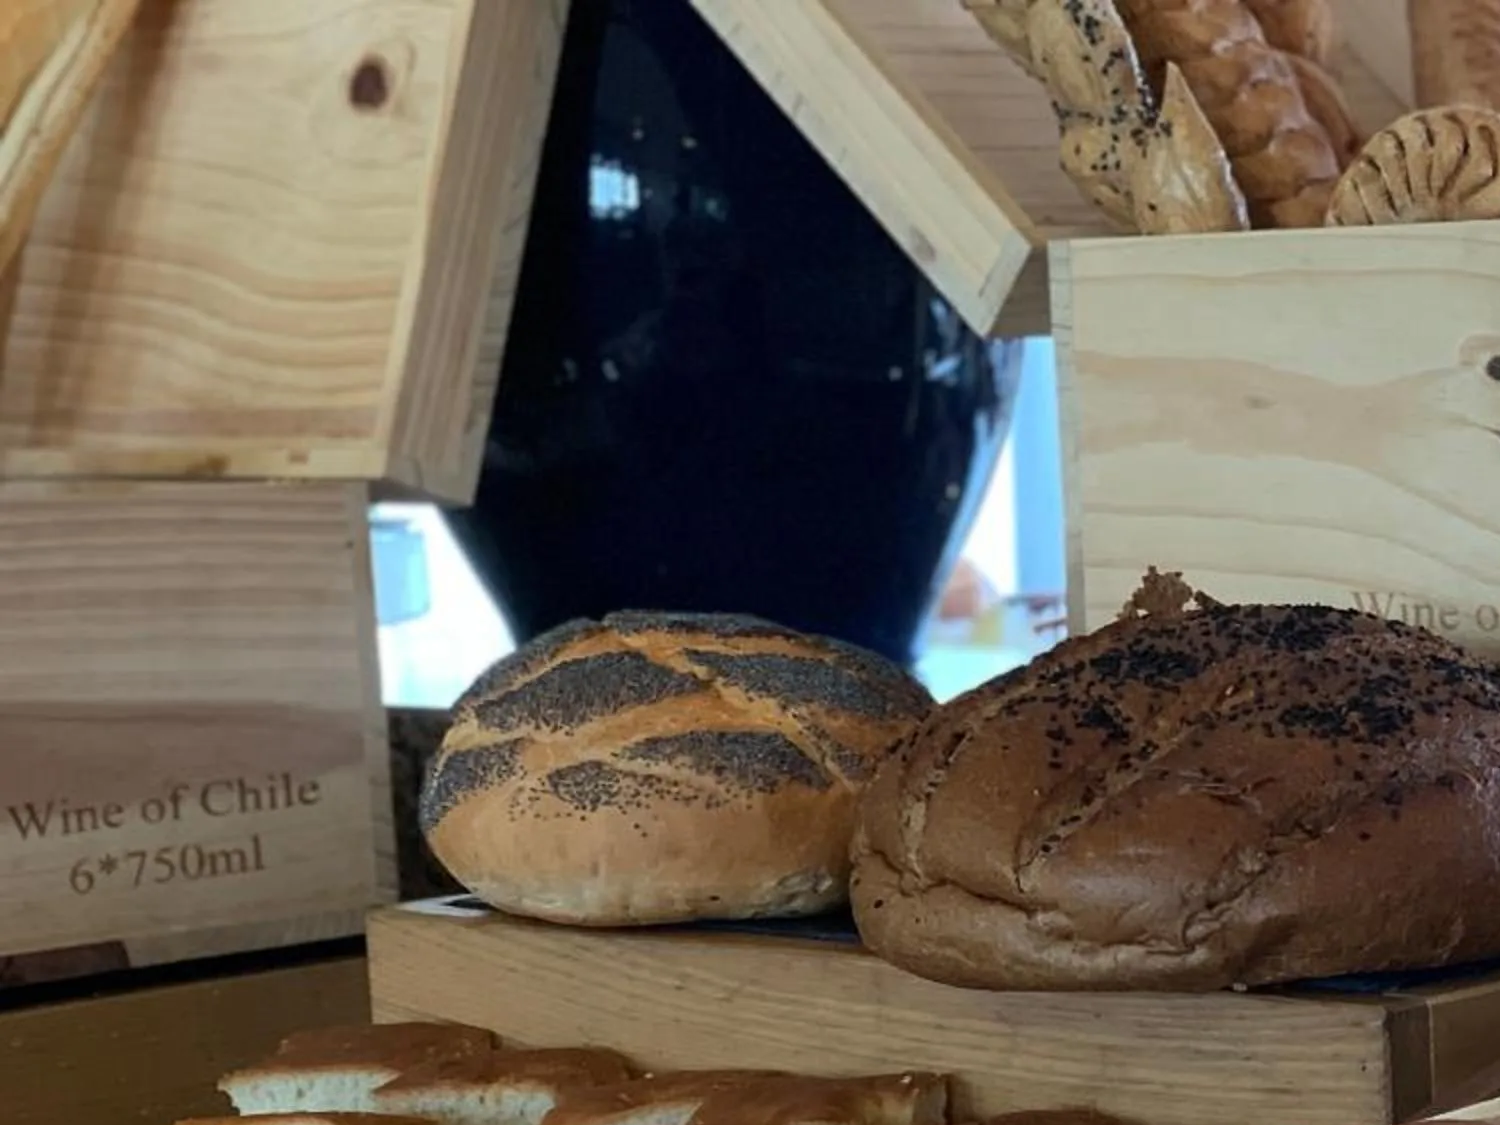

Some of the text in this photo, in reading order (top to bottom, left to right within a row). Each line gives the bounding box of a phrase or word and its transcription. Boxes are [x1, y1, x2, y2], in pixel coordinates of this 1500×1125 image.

[1351, 590, 1459, 631] Wine
[8, 772, 322, 841] Wine of Chile
